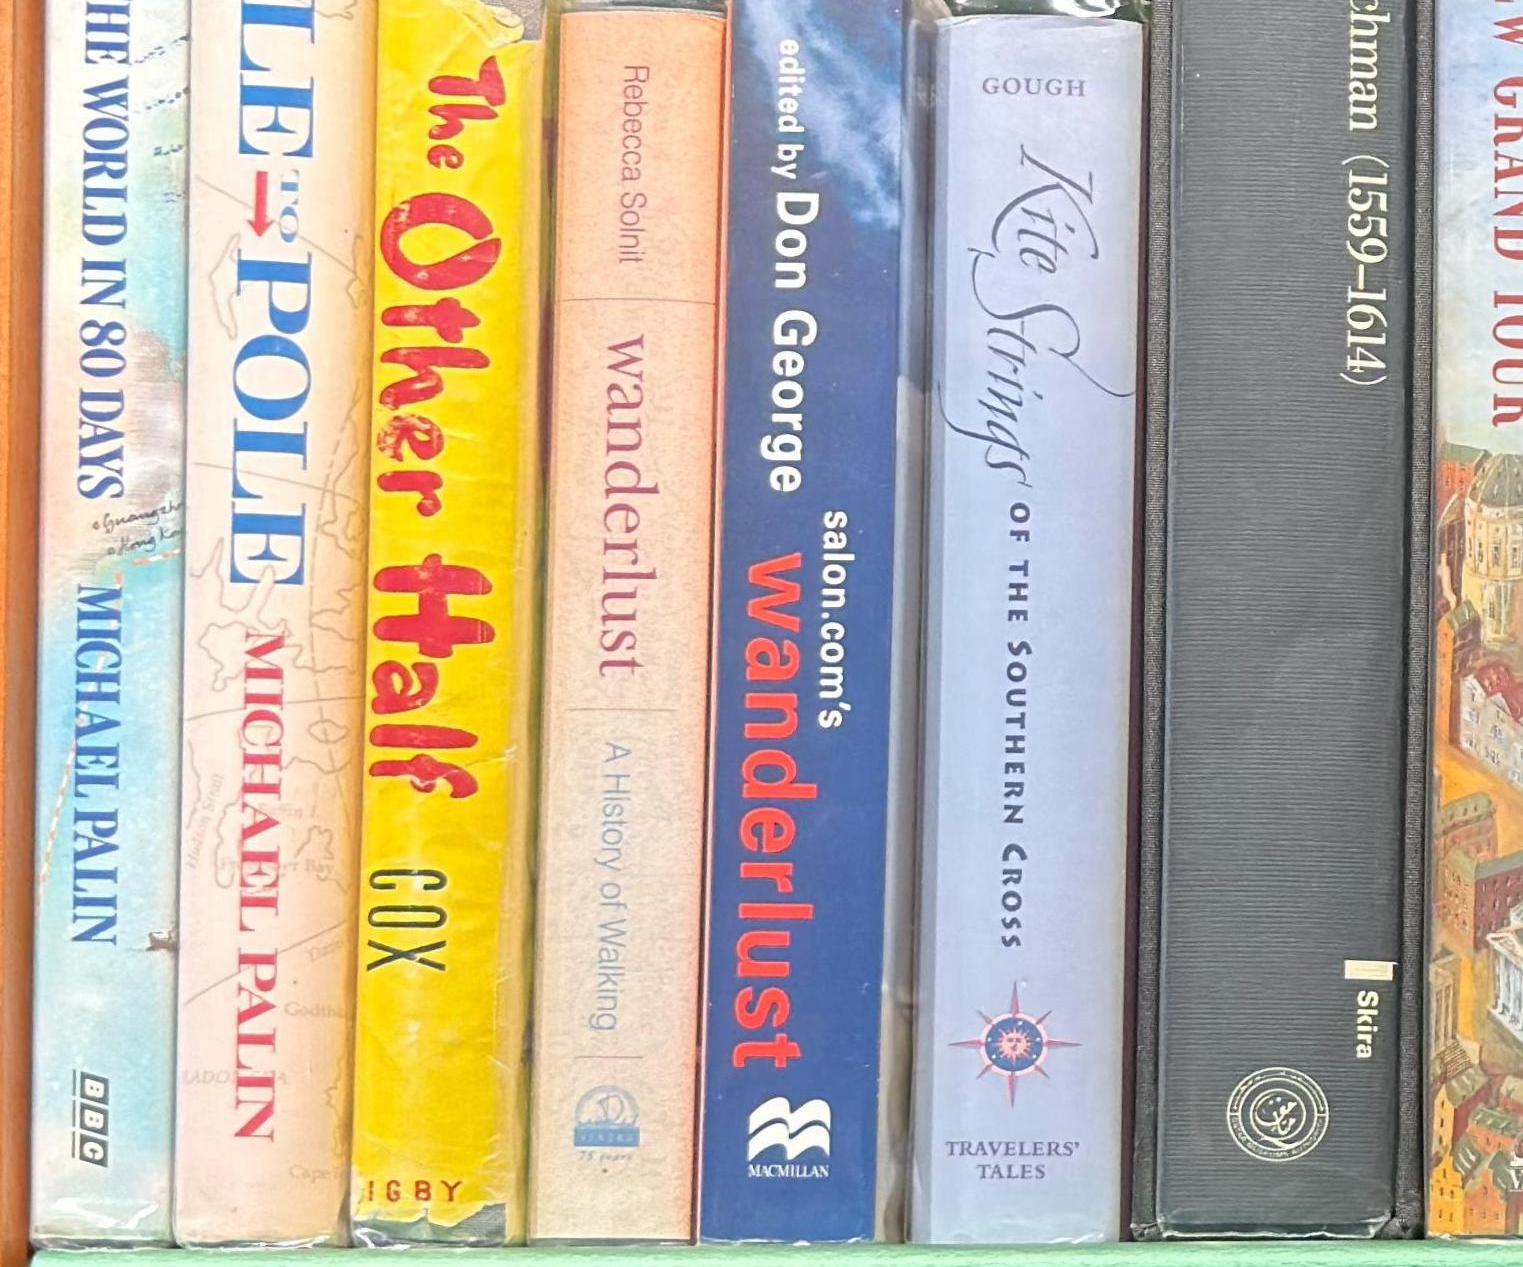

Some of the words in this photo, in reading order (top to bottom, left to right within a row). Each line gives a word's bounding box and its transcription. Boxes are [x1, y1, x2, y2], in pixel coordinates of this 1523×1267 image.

[428, 56, 506, 170] The
[622, 65, 650, 184] Rebecca
[777, 37, 808, 134] edited
[982, 77, 1087, 98] GOUGH
[81, 76, 130, 245] WORLD
[769, 143, 806, 181] by
[618, 192, 648, 265] Solnit
[774, 192, 820, 290] Don
[80, 258, 127, 308] IN
[79, 319, 127, 378] 80
[376, 192, 503, 517] Other
[77, 388, 127, 499] DAYS
[760, 308, 819, 493] George
[599, 335, 660, 678] wanderlust
[817, 509, 856, 729] salon.com's
[369, 552, 497, 801] Half
[237, 628, 288, 931] MICHAEL
[604, 743, 631, 765] A
[593, 773, 631, 872] History
[732, 553, 819, 1069] wanderlust
[367, 869, 449, 973] COX
[599, 884, 625, 910] of
[588, 918, 628, 1033] Walking
[1355, 989, 1380, 1060] Skira
[234, 947, 278, 1143] PALIN
[79, 1071, 109, 1167] BBC
[946, 1141, 1079, 1158] TRAVELERS'
[747, 1163, 829, 1179] MACMILLAN
[976, 1163, 1046, 1180] TALES
